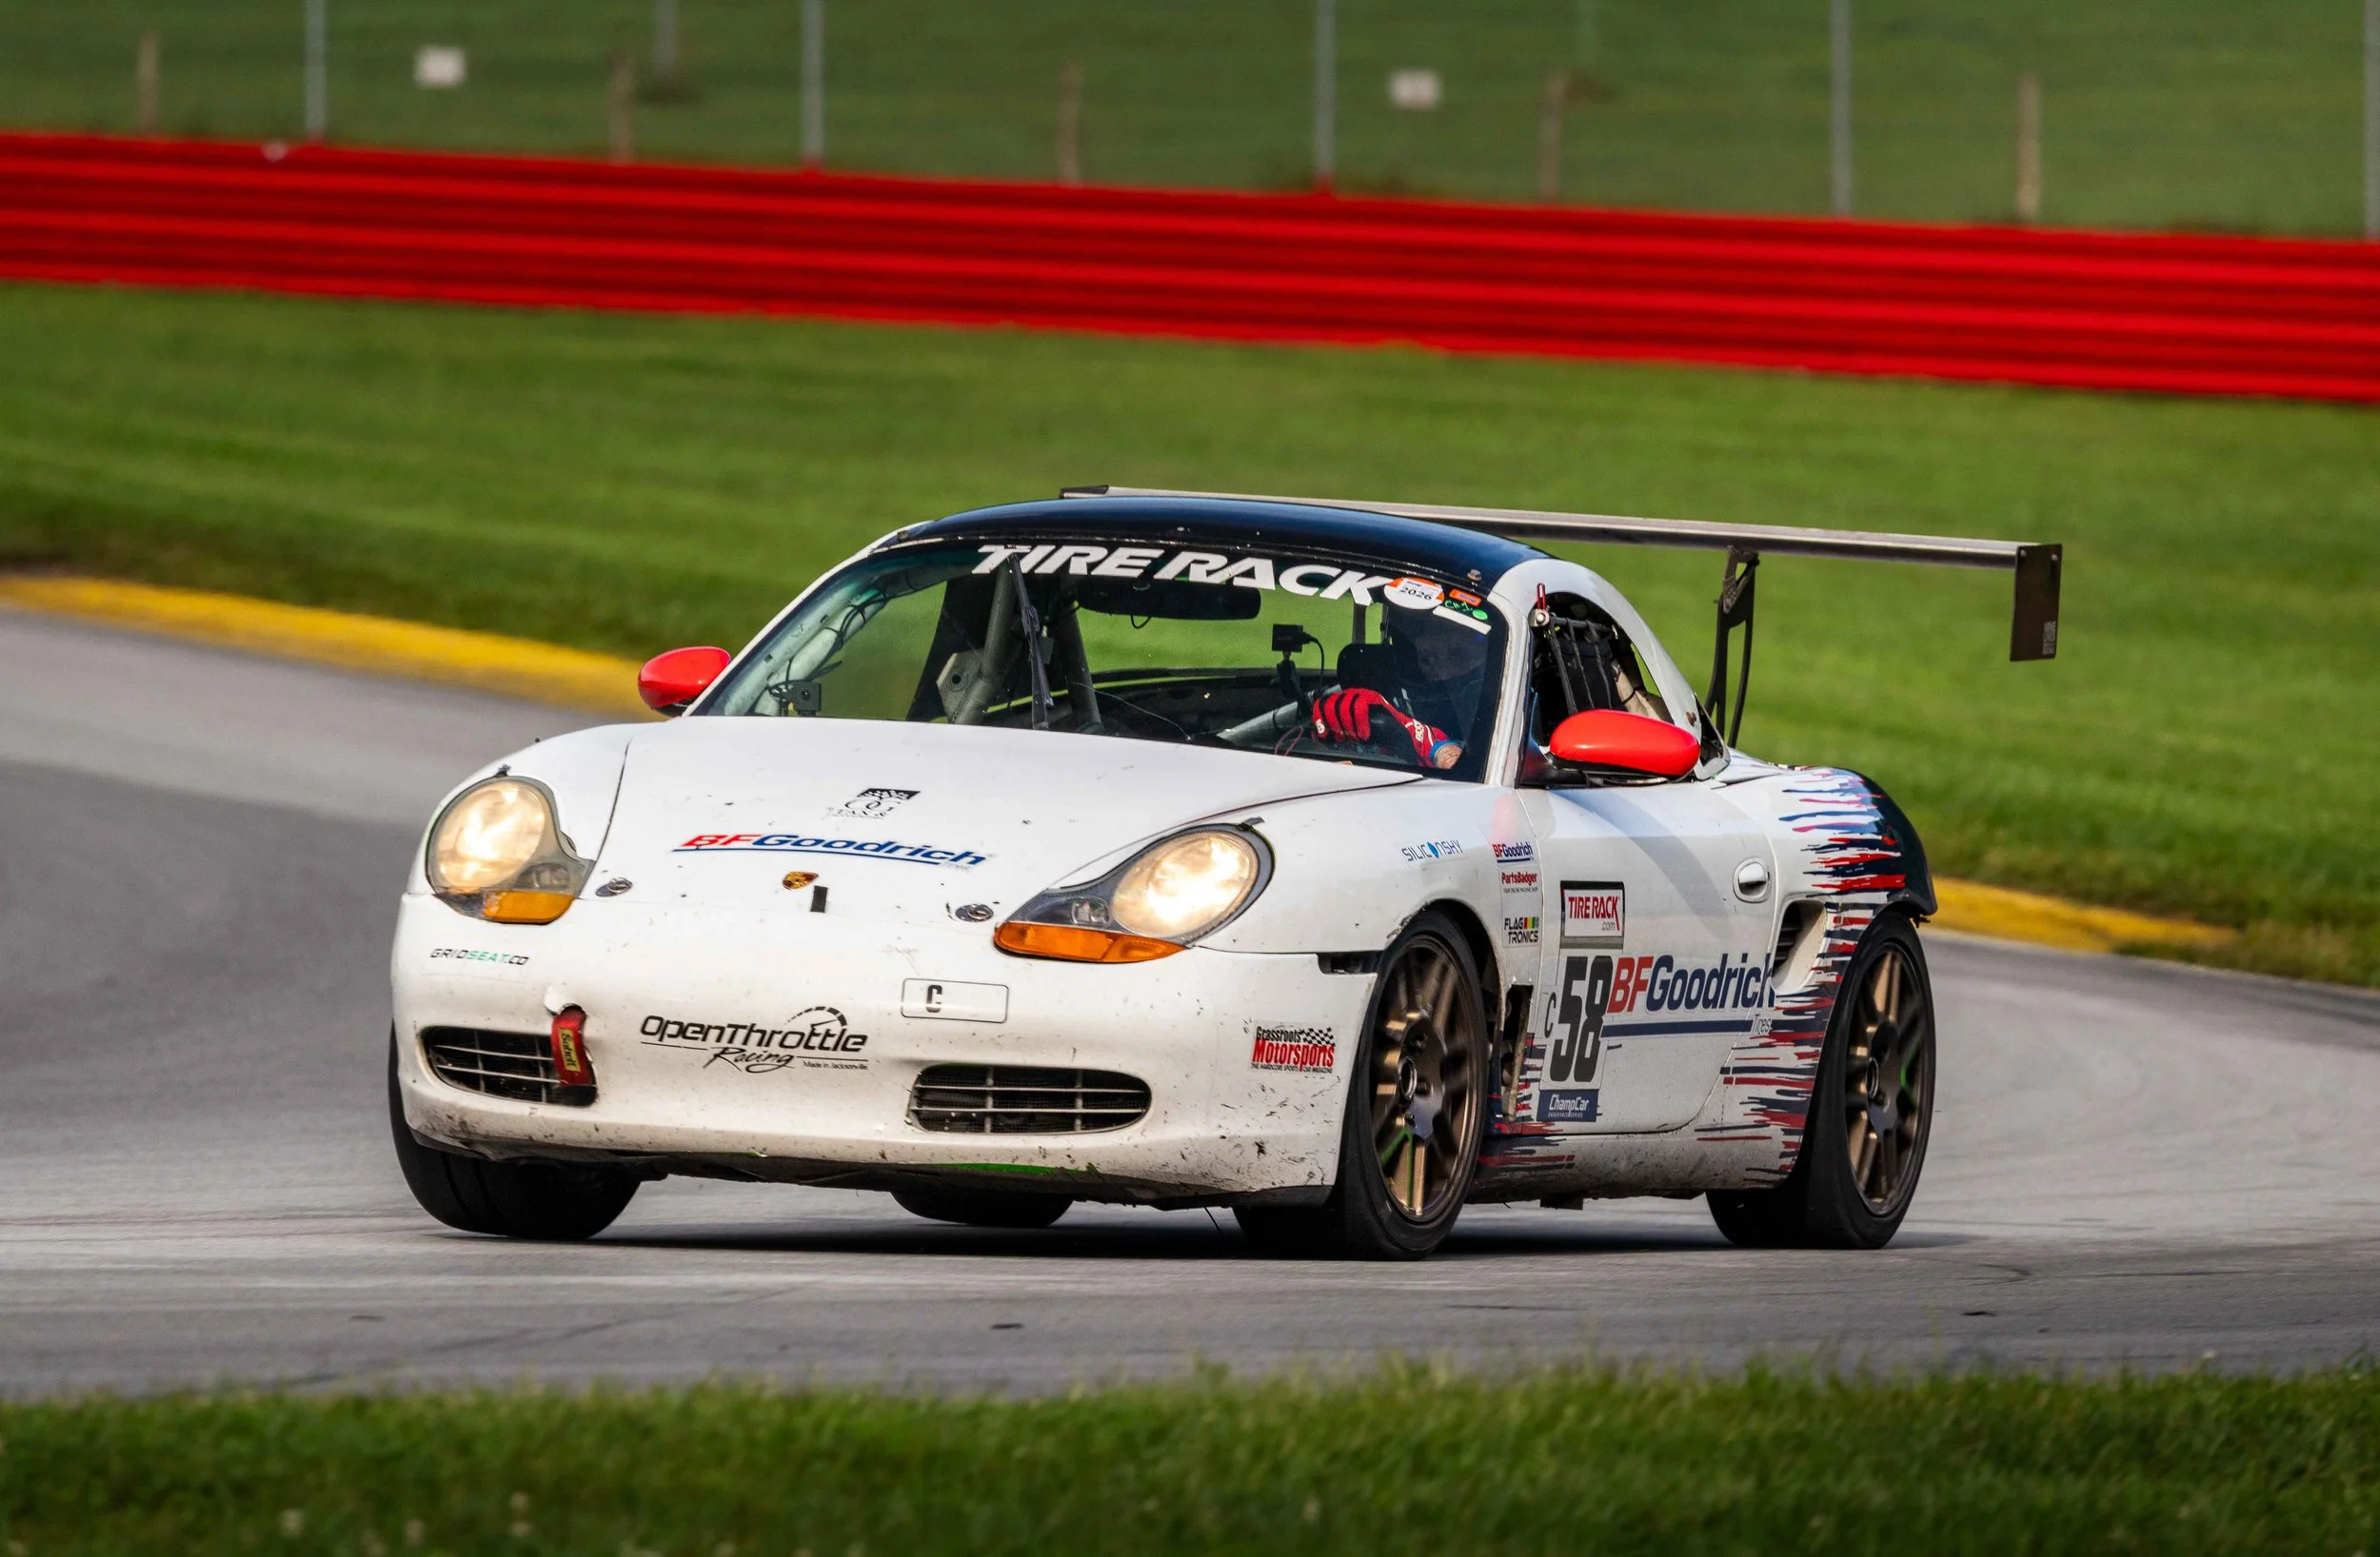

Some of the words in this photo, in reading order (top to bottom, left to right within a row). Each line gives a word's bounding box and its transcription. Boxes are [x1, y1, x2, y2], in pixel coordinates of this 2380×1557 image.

[971, 544, 1164, 578] TIRE
[1153, 551, 1394, 606] RACK
[1398, 586, 1432, 601] 2026
[680, 834, 986, 865] BFGoodrich
[1493, 841, 1534, 857] BFGoodrich
[1501, 872, 1537, 886] PartsBadger
[1504, 916, 1523, 930] FLAG
[1568, 897, 1591, 919] TIRE
[1591, 896, 1620, 931] RACK
[1508, 931, 1538, 944] TRONICS
[1601, 921, 1616, 932] .com
[430, 948, 529, 966] GRIDSEAT.CO
[1607, 953, 1775, 1013] BFGoodrich
[1543, 991, 1557, 1038] C
[1550, 956, 1613, 1082] 58
[640, 1015, 868, 1053] OpenThrottle
[1256, 1025, 1301, 1043] Grassroots
[703, 1046, 795, 1074] Racing
[1252, 1037, 1335, 1073] Motorsports
[1549, 1094, 1590, 1116] ChampCar
